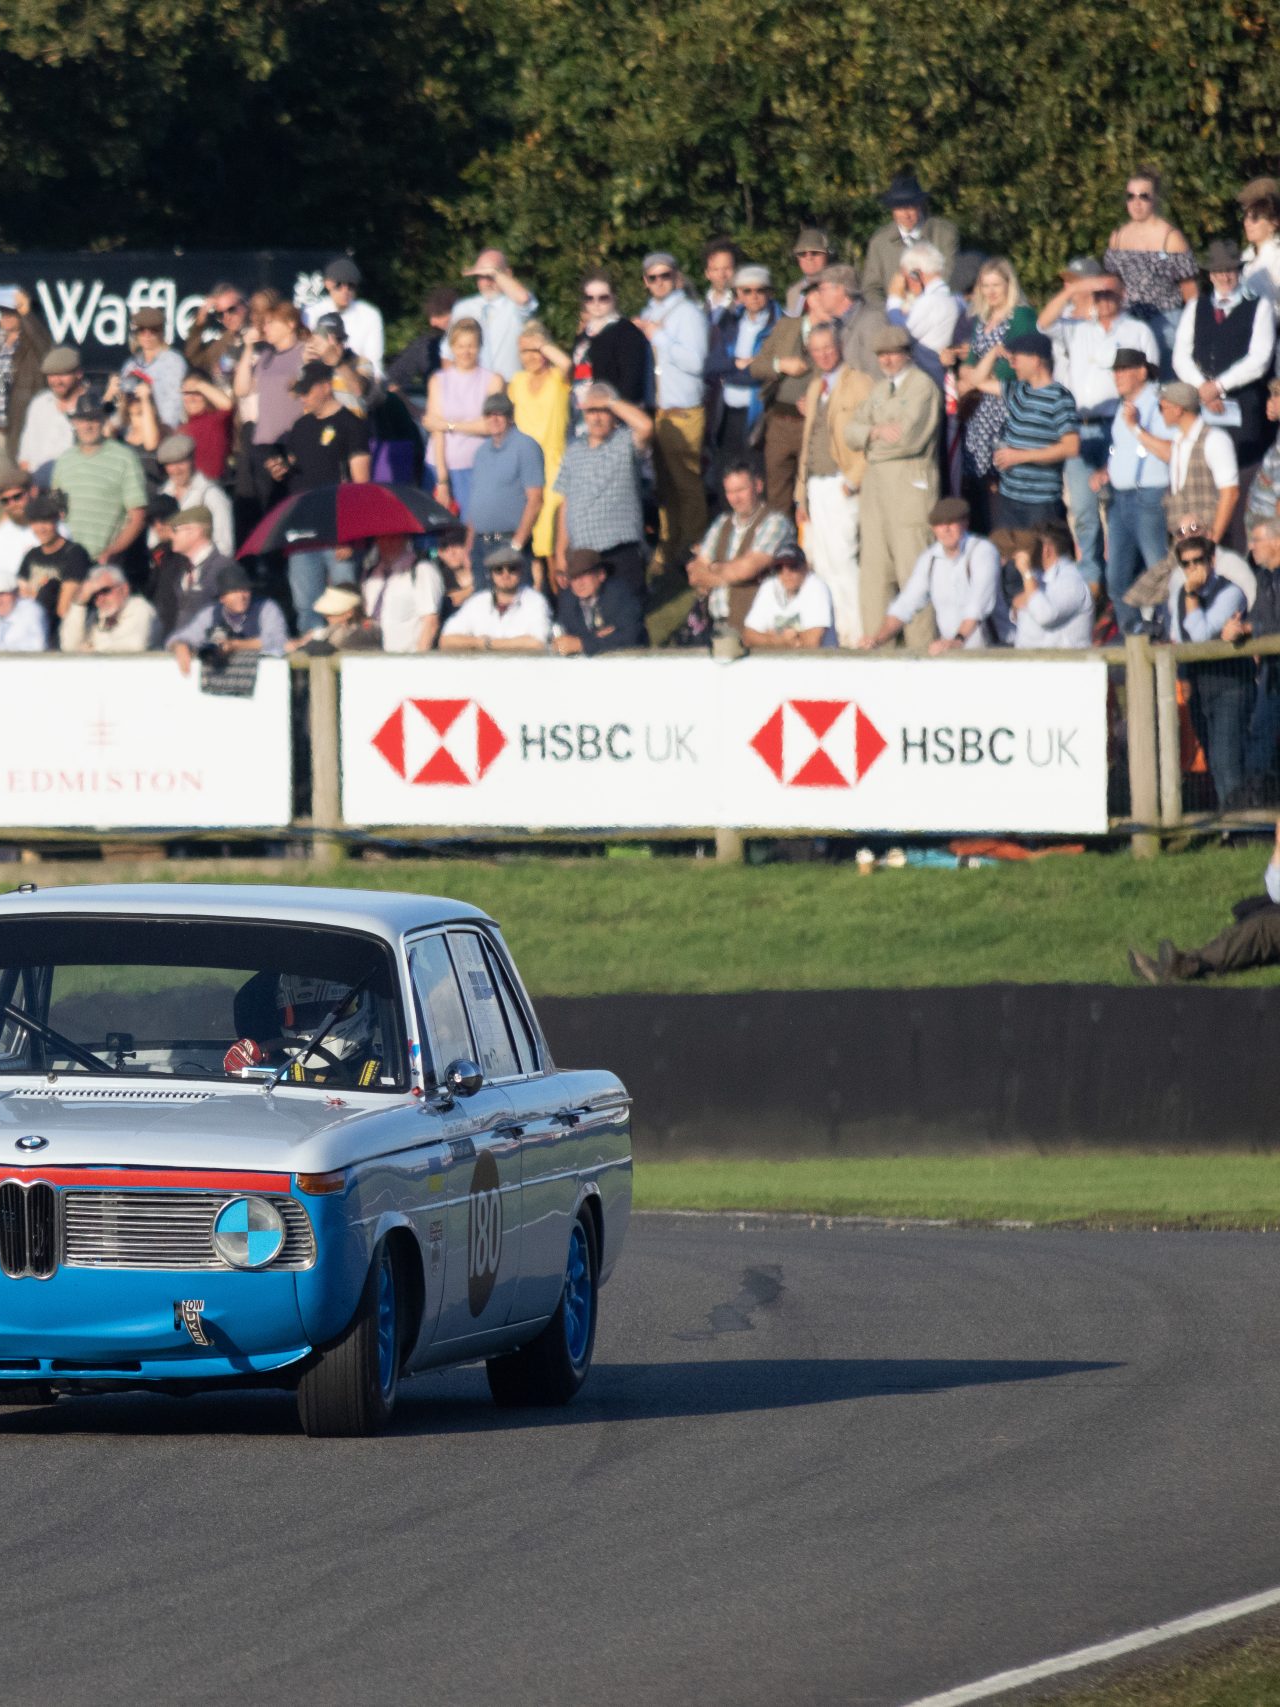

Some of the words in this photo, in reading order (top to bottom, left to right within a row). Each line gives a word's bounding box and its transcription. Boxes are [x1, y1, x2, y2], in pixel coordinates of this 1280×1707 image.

[36, 277, 221, 345] Waffle
[520, 723, 632, 762] HSBC
[645, 724, 698, 763] UK
[902, 726, 1015, 766] HSBC
[1026, 728, 1081, 767] UK
[6, 769, 205, 794] EDMISTON
[469, 1187, 502, 1278] 180
[183, 1300, 204, 1310] TOW
